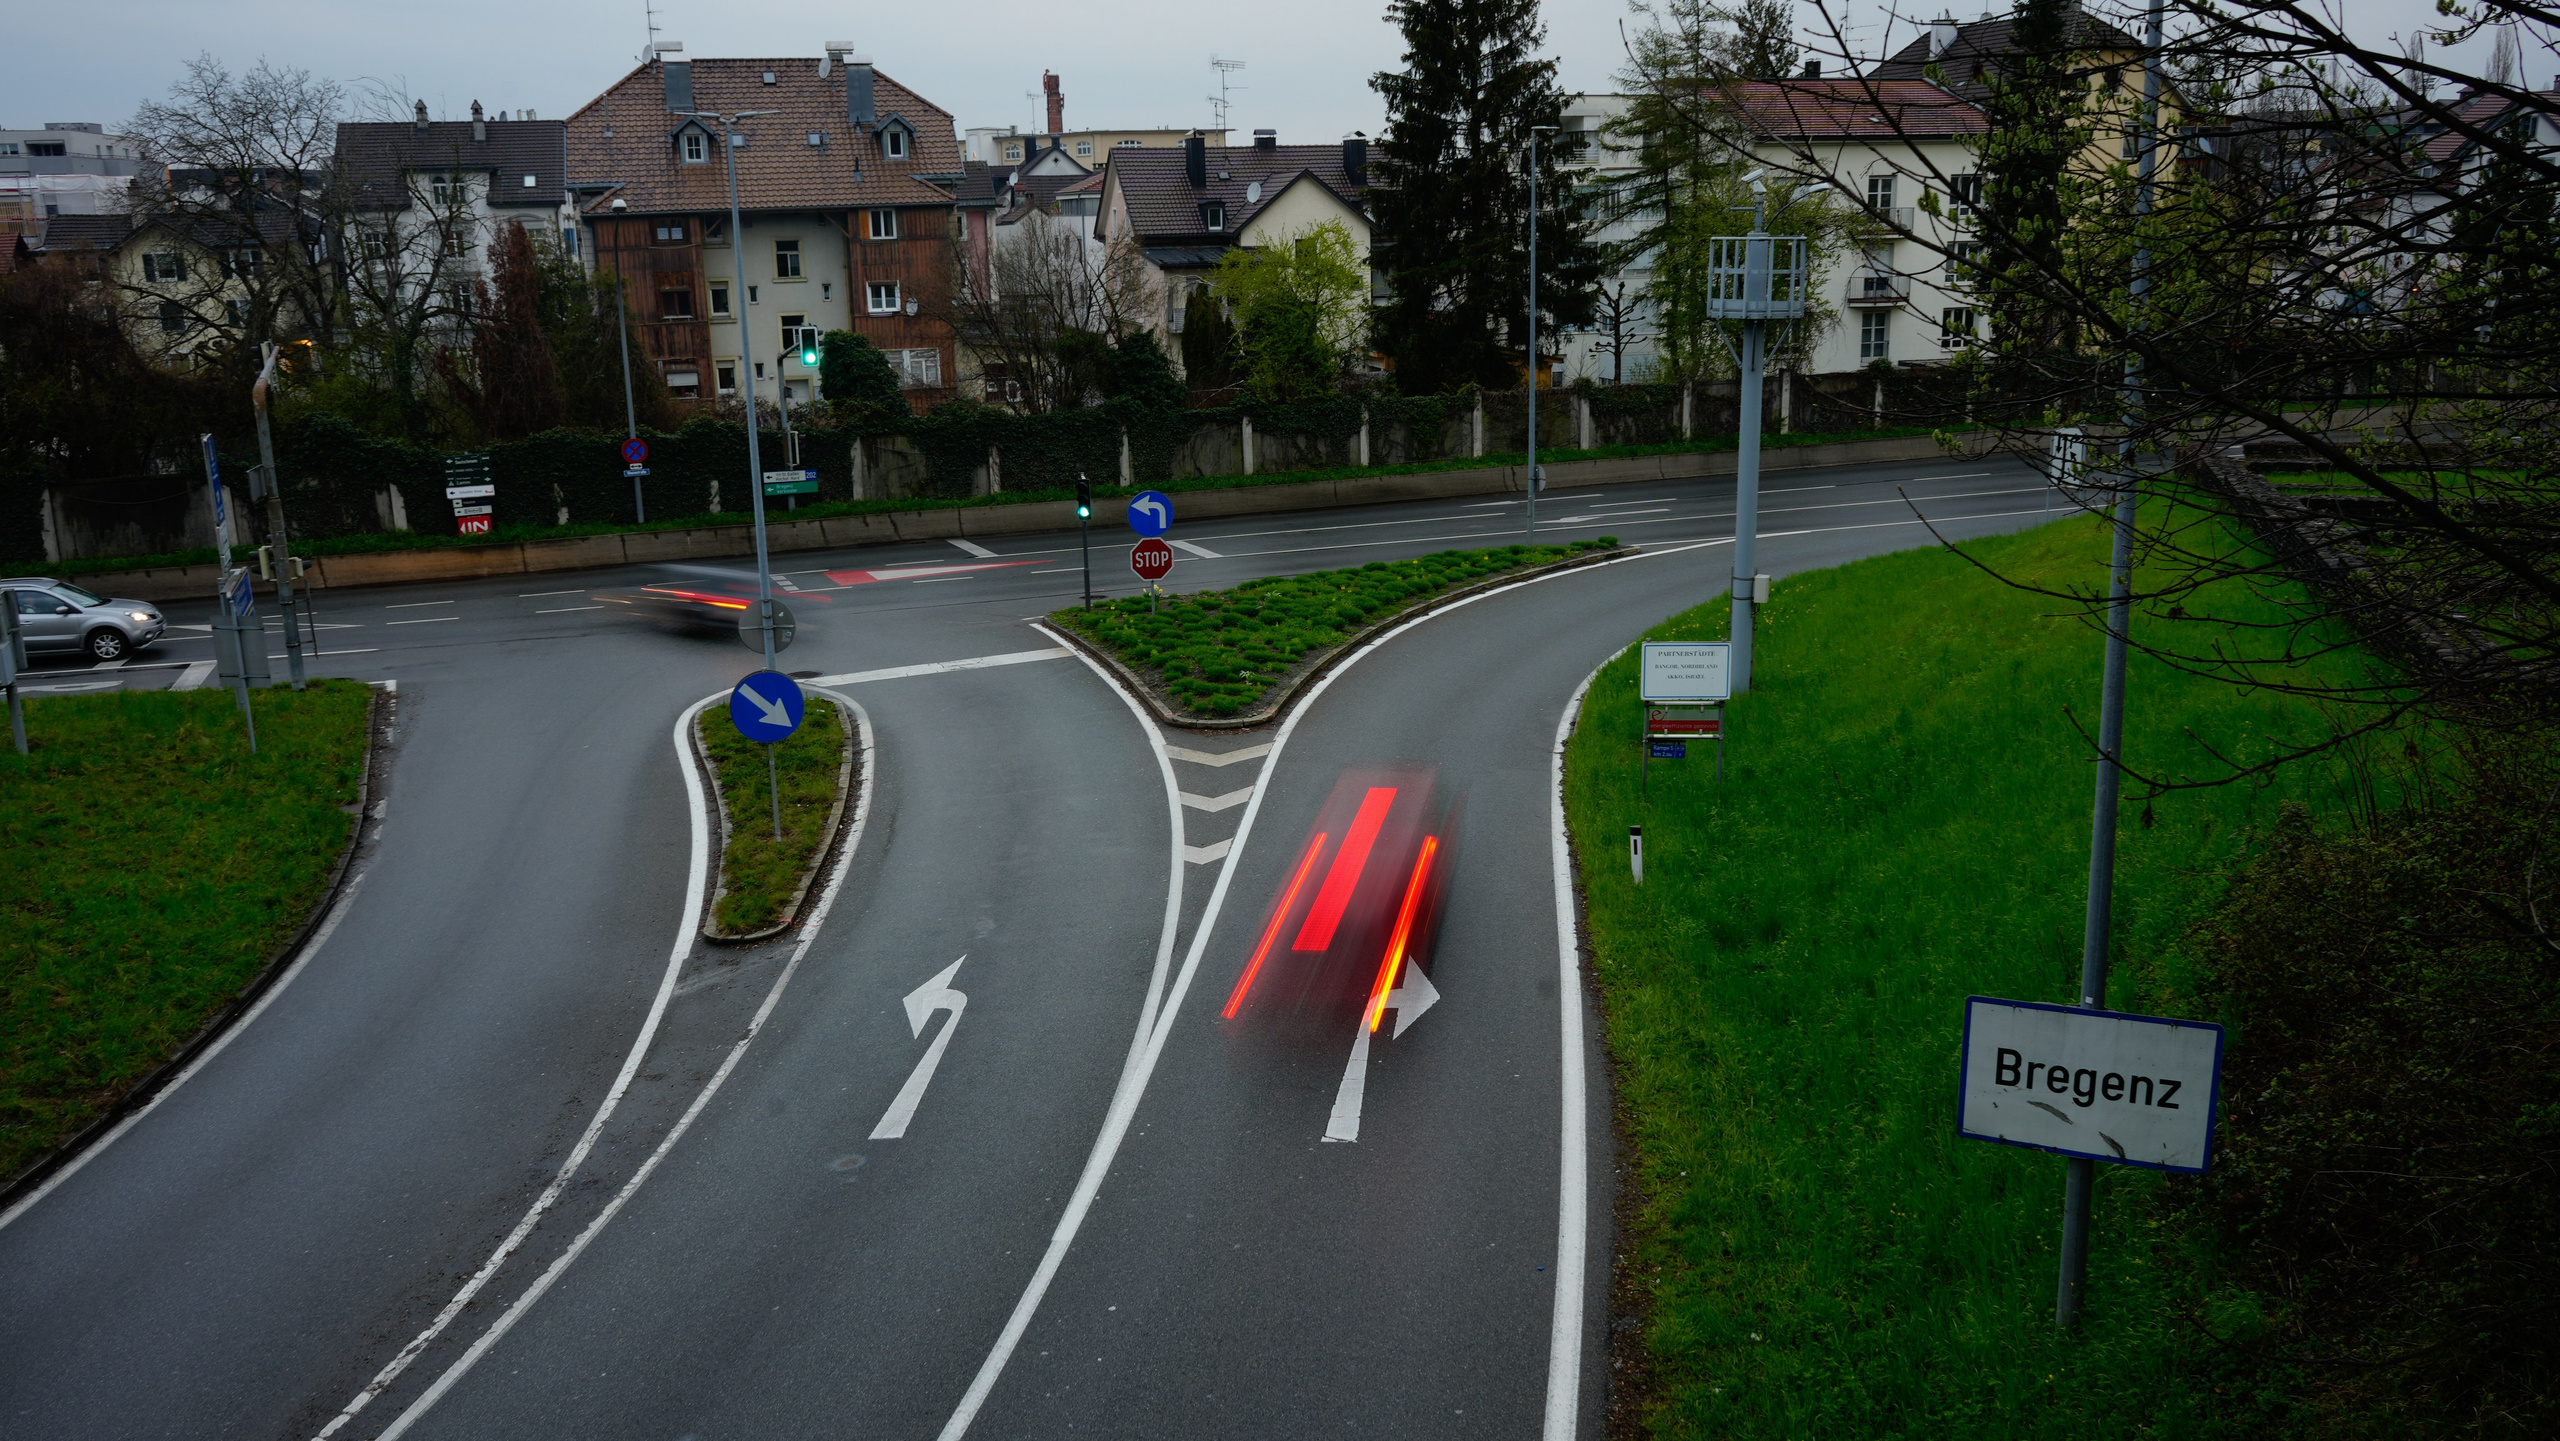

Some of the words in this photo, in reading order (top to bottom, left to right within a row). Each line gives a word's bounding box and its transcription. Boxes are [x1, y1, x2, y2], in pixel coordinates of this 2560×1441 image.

[806, 471, 817, 479] 202
[1135, 551, 1169, 568] STOP
[1995, 1047, 2182, 1110] Bregenz
